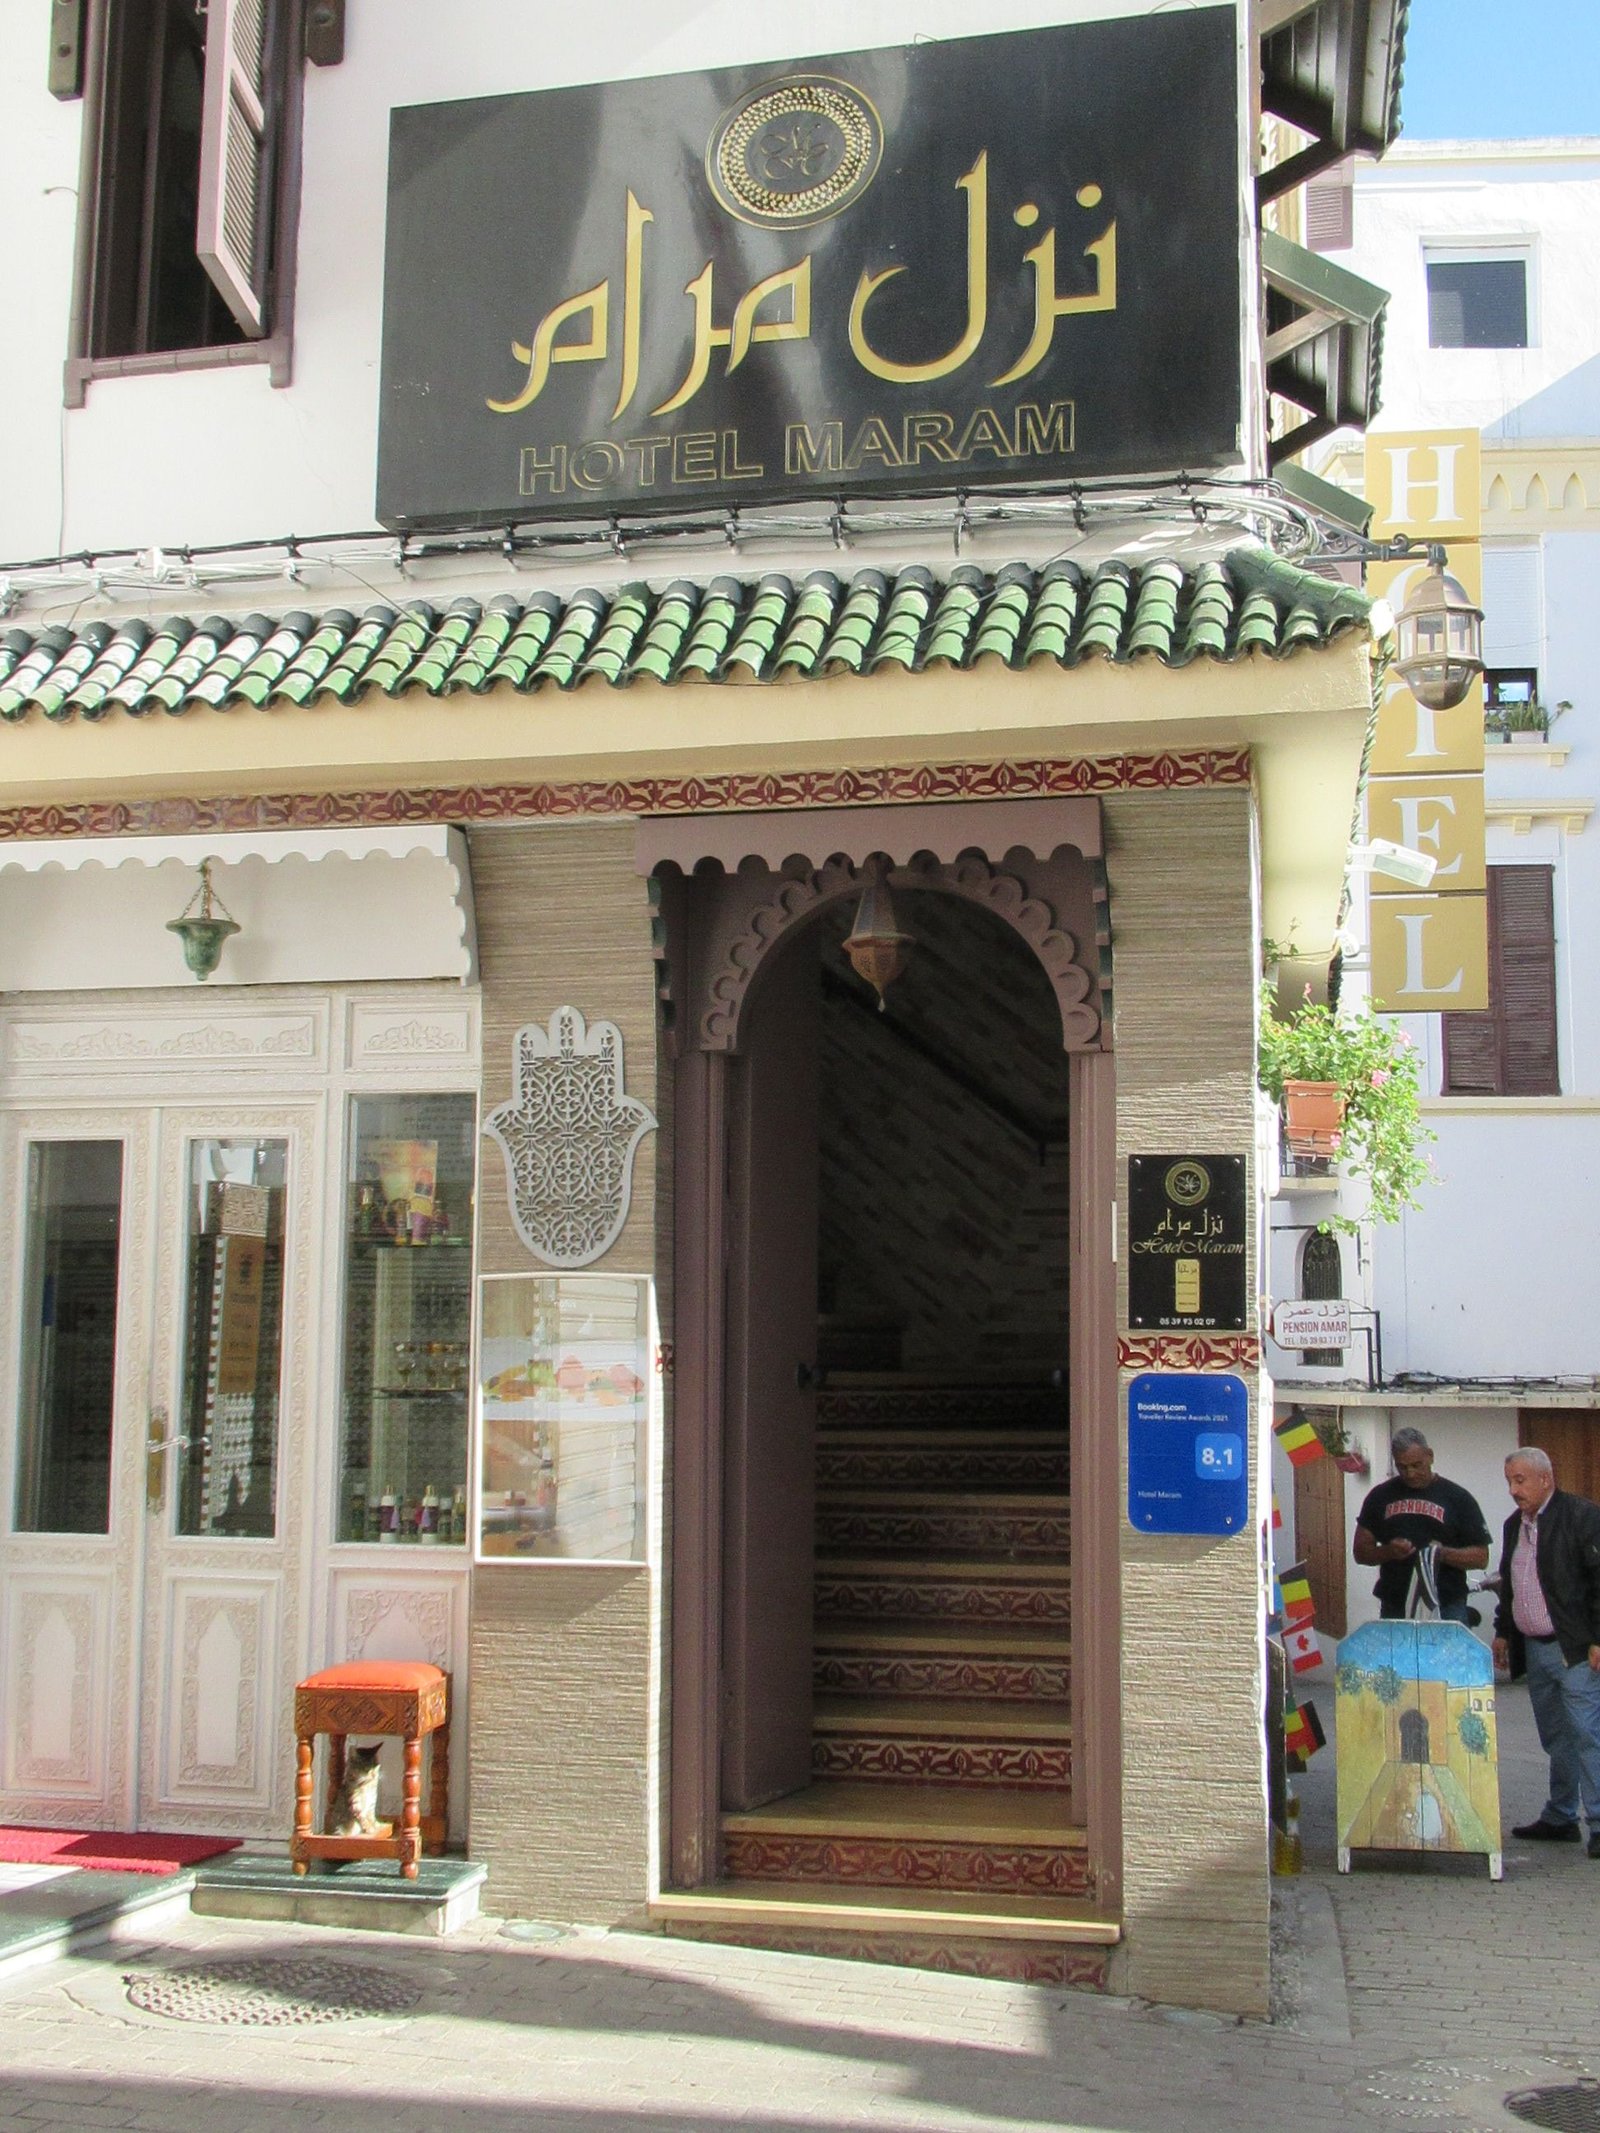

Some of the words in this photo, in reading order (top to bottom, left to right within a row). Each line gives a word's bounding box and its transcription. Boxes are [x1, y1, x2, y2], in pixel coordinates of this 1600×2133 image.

[848, 148, 1116, 388] نزل
[486, 186, 811, 423] مرام
[519, 430, 763, 496] HOTEL
[785, 401, 1075, 475] MARAM
[1154, 1208, 1191, 1236] مرام
[1193, 1208, 1223, 1236] نزل
[1132, 1238, 1183, 1253] Hotel
[1183, 1239, 1244, 1253] Maram
[1318, 1304, 1346, 1317] نزل
[1283, 1321, 1319, 1333] PENSION
[1320, 1321, 1348, 1332] AMAR
[1137, 1402, 1187, 1412] Booking.com
[1202, 1447, 1233, 1466] 8.1
